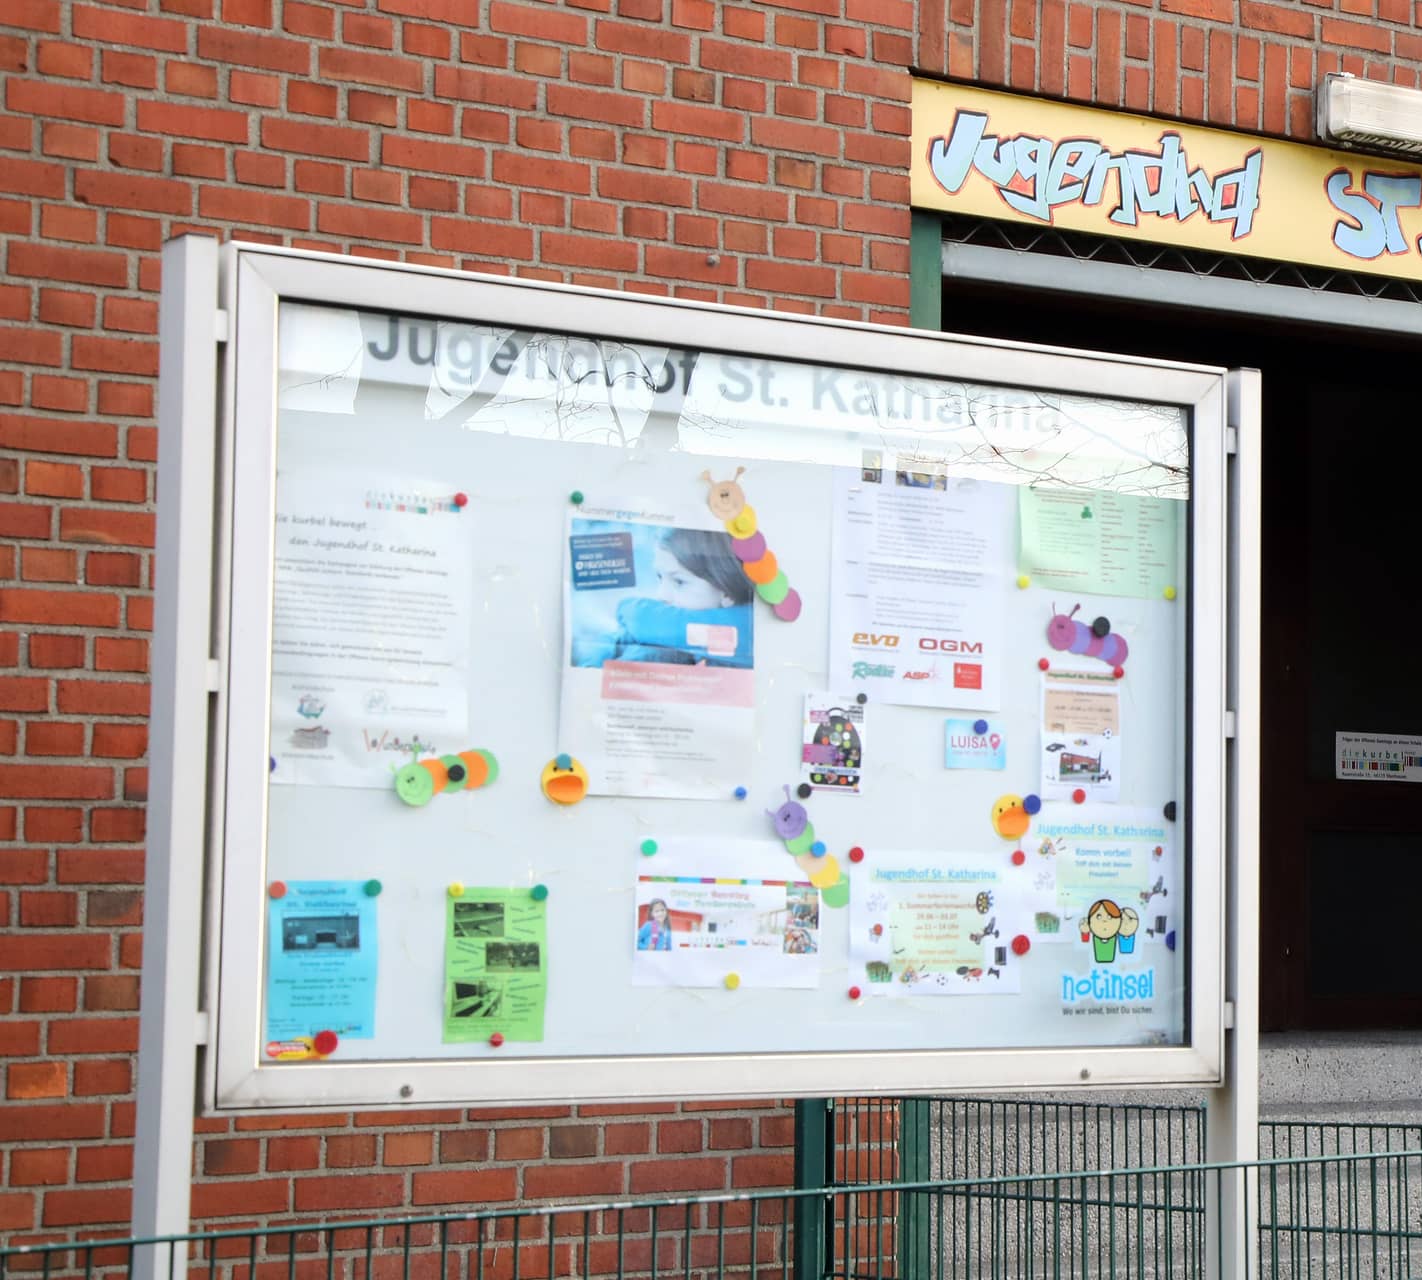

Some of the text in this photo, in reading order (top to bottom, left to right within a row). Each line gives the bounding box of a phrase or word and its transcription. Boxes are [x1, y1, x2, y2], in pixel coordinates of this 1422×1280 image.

[367, 315, 699, 396] Jugendhof
[717, 355, 789, 408] St.
[851, 631, 983, 654] evo OGM
[951, 735, 988, 748] LUISA
[1062, 968, 1154, 1001] notinsel
